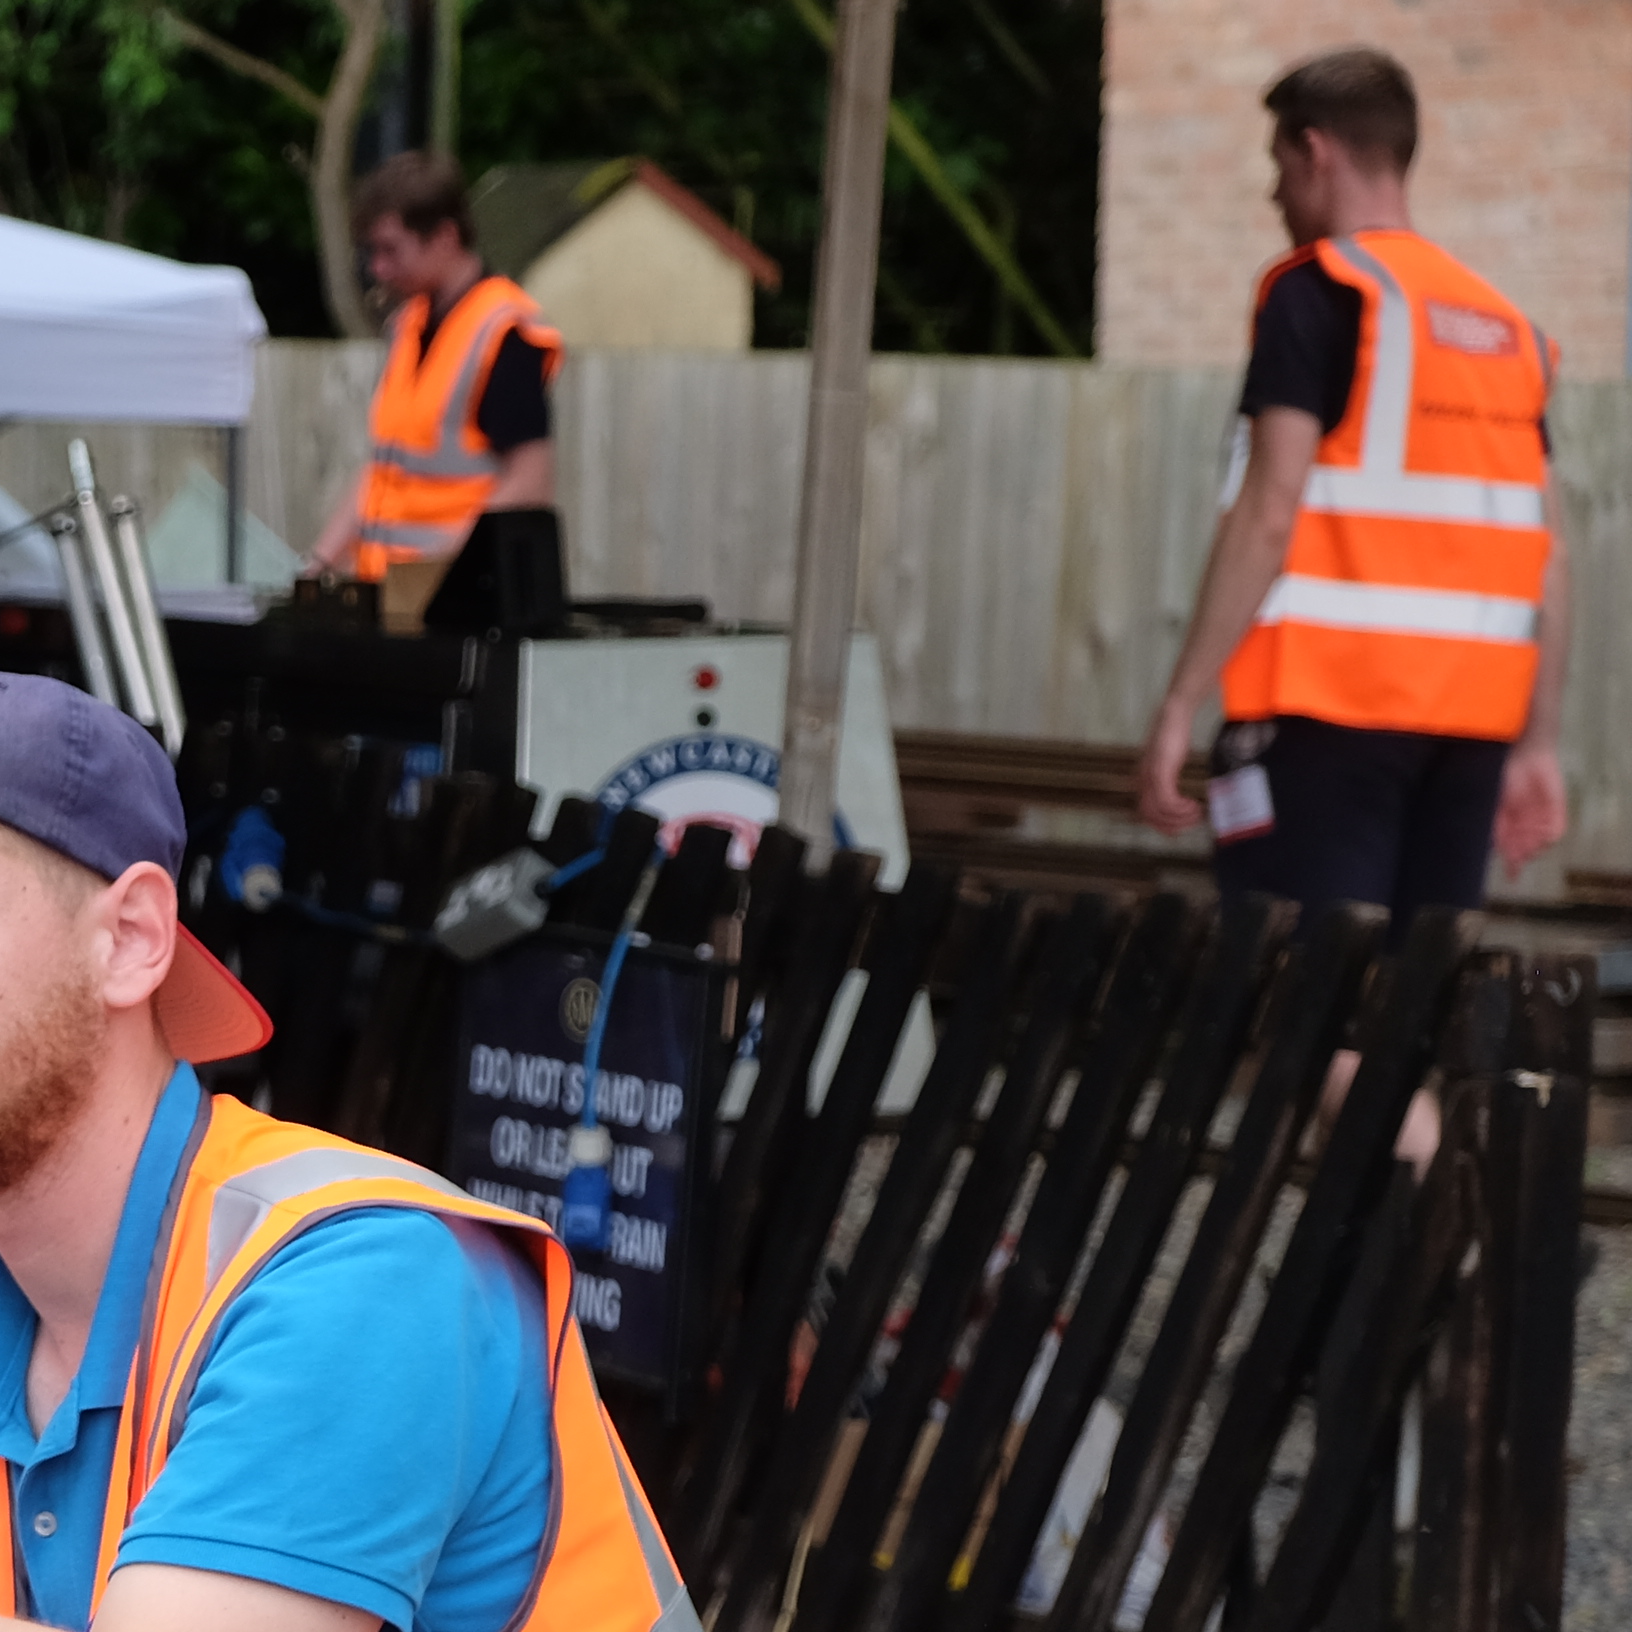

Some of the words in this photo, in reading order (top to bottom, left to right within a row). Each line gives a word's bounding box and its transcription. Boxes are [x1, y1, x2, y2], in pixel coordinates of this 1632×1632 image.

[599, 736, 779, 812] NEWCAST
[469, 1044, 512, 1099] DO
[511, 1052, 565, 1109] NOT
[561, 1062, 645, 1127] SAND
[643, 1080, 684, 1134] UP
[490, 1115, 532, 1168] OR
[612, 1142, 654, 1199] UT
[609, 1210, 667, 1273] RAIN
